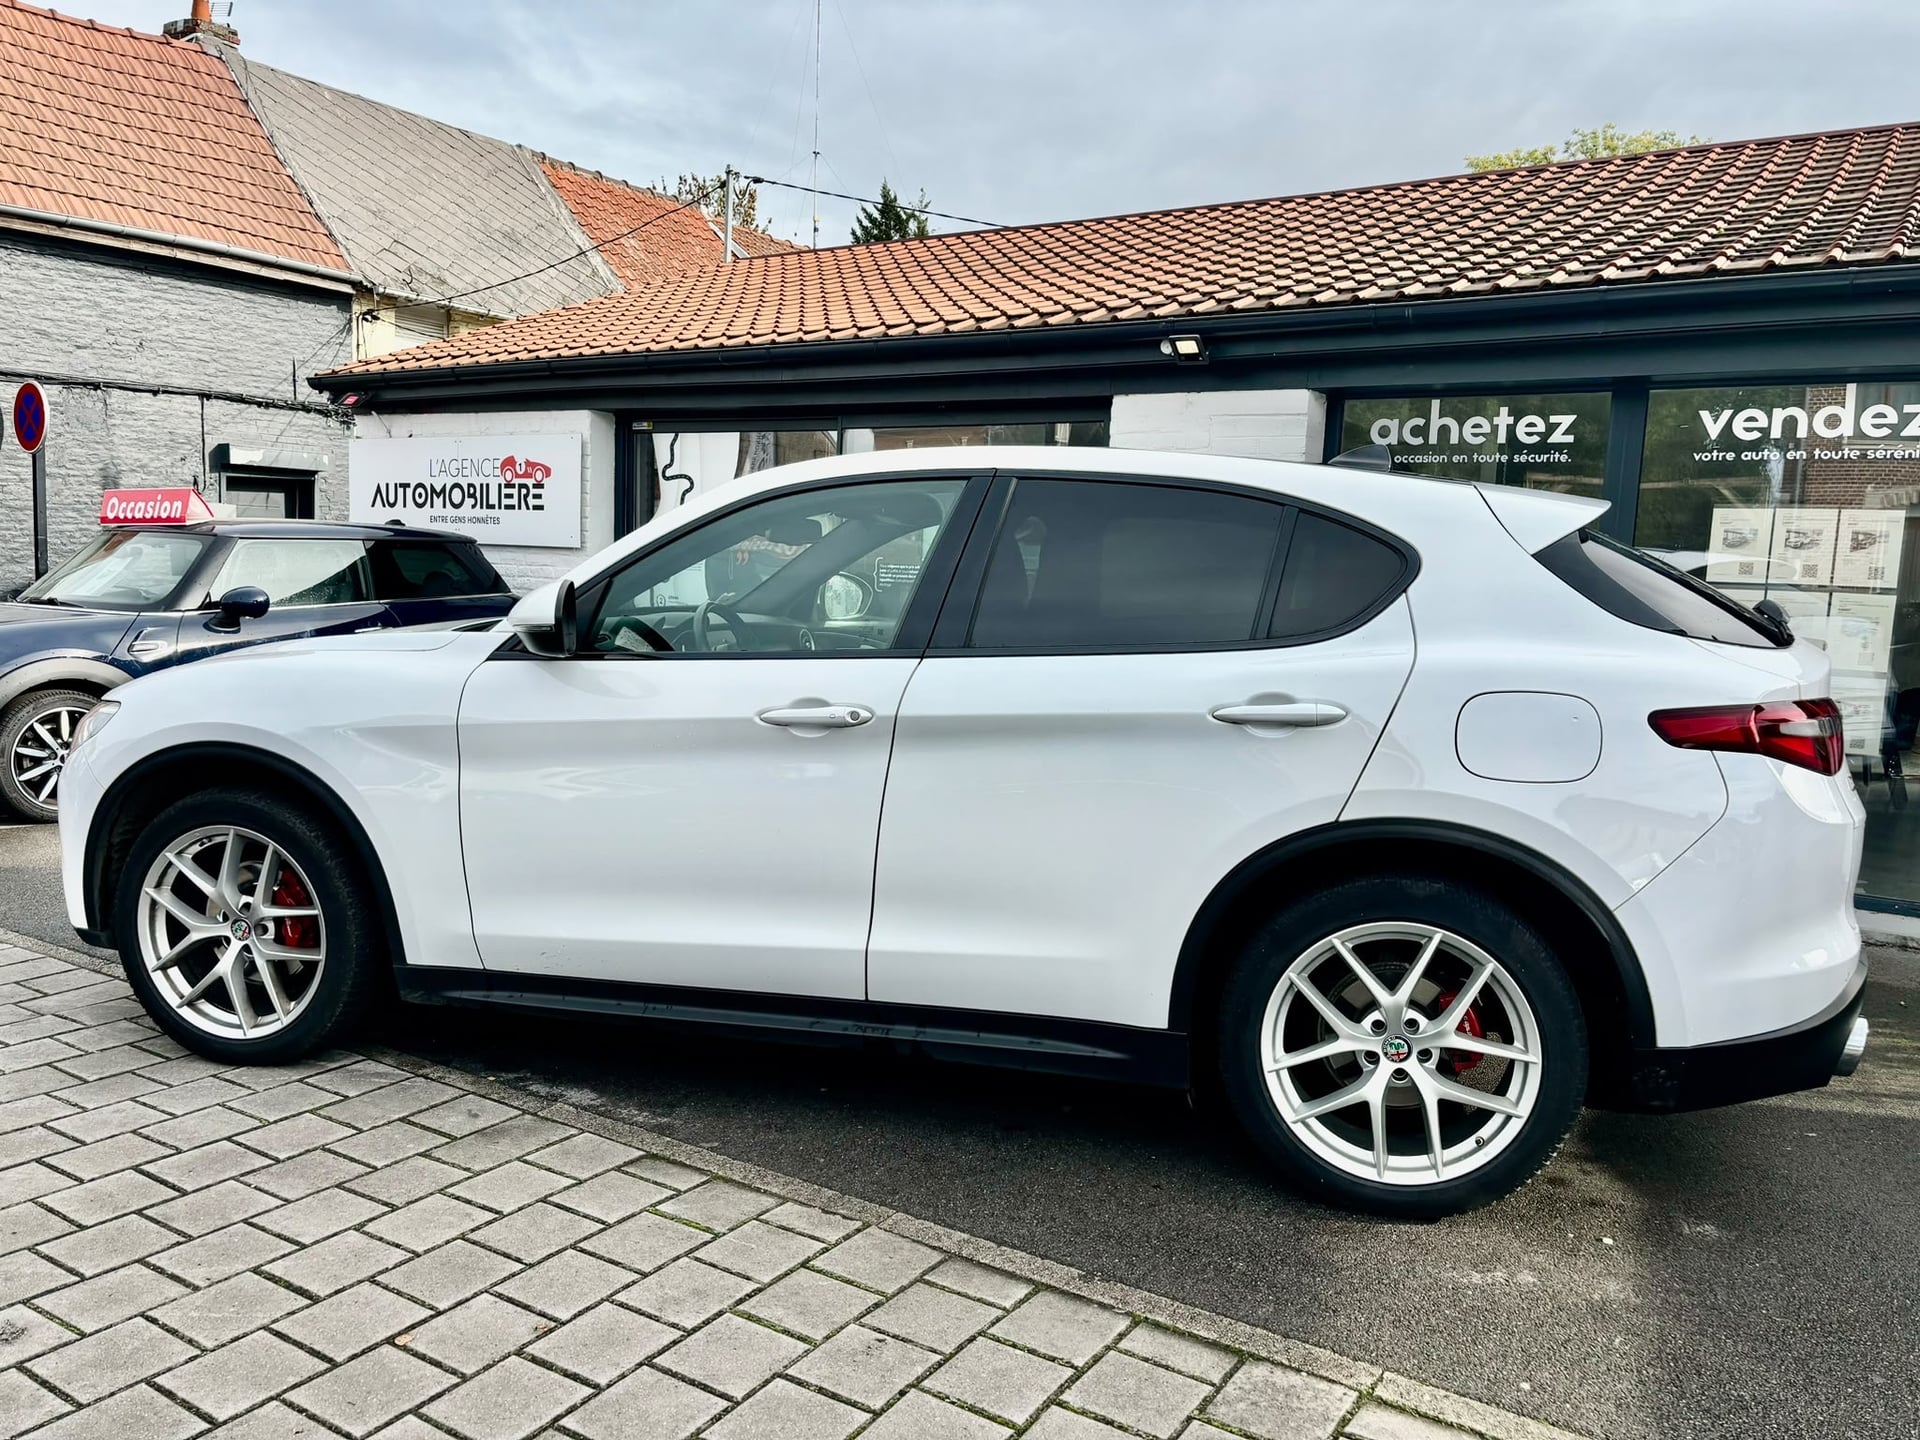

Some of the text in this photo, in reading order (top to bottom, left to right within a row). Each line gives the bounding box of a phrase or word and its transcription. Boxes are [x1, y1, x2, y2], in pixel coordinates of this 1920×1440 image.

[1370, 399, 1577, 445] achetez
[1394, 449, 1572, 463] occasion en toute sécurité.
[1693, 449, 1736, 461] votre
[1741, 448, 1780, 461] auto
[1786, 448, 1807, 460] en
[1813, 447, 1860, 460] toute
[106, 494, 182, 519] Occasion
[430, 515, 449, 524] ENTRE
[450, 515, 466, 524] GENS
